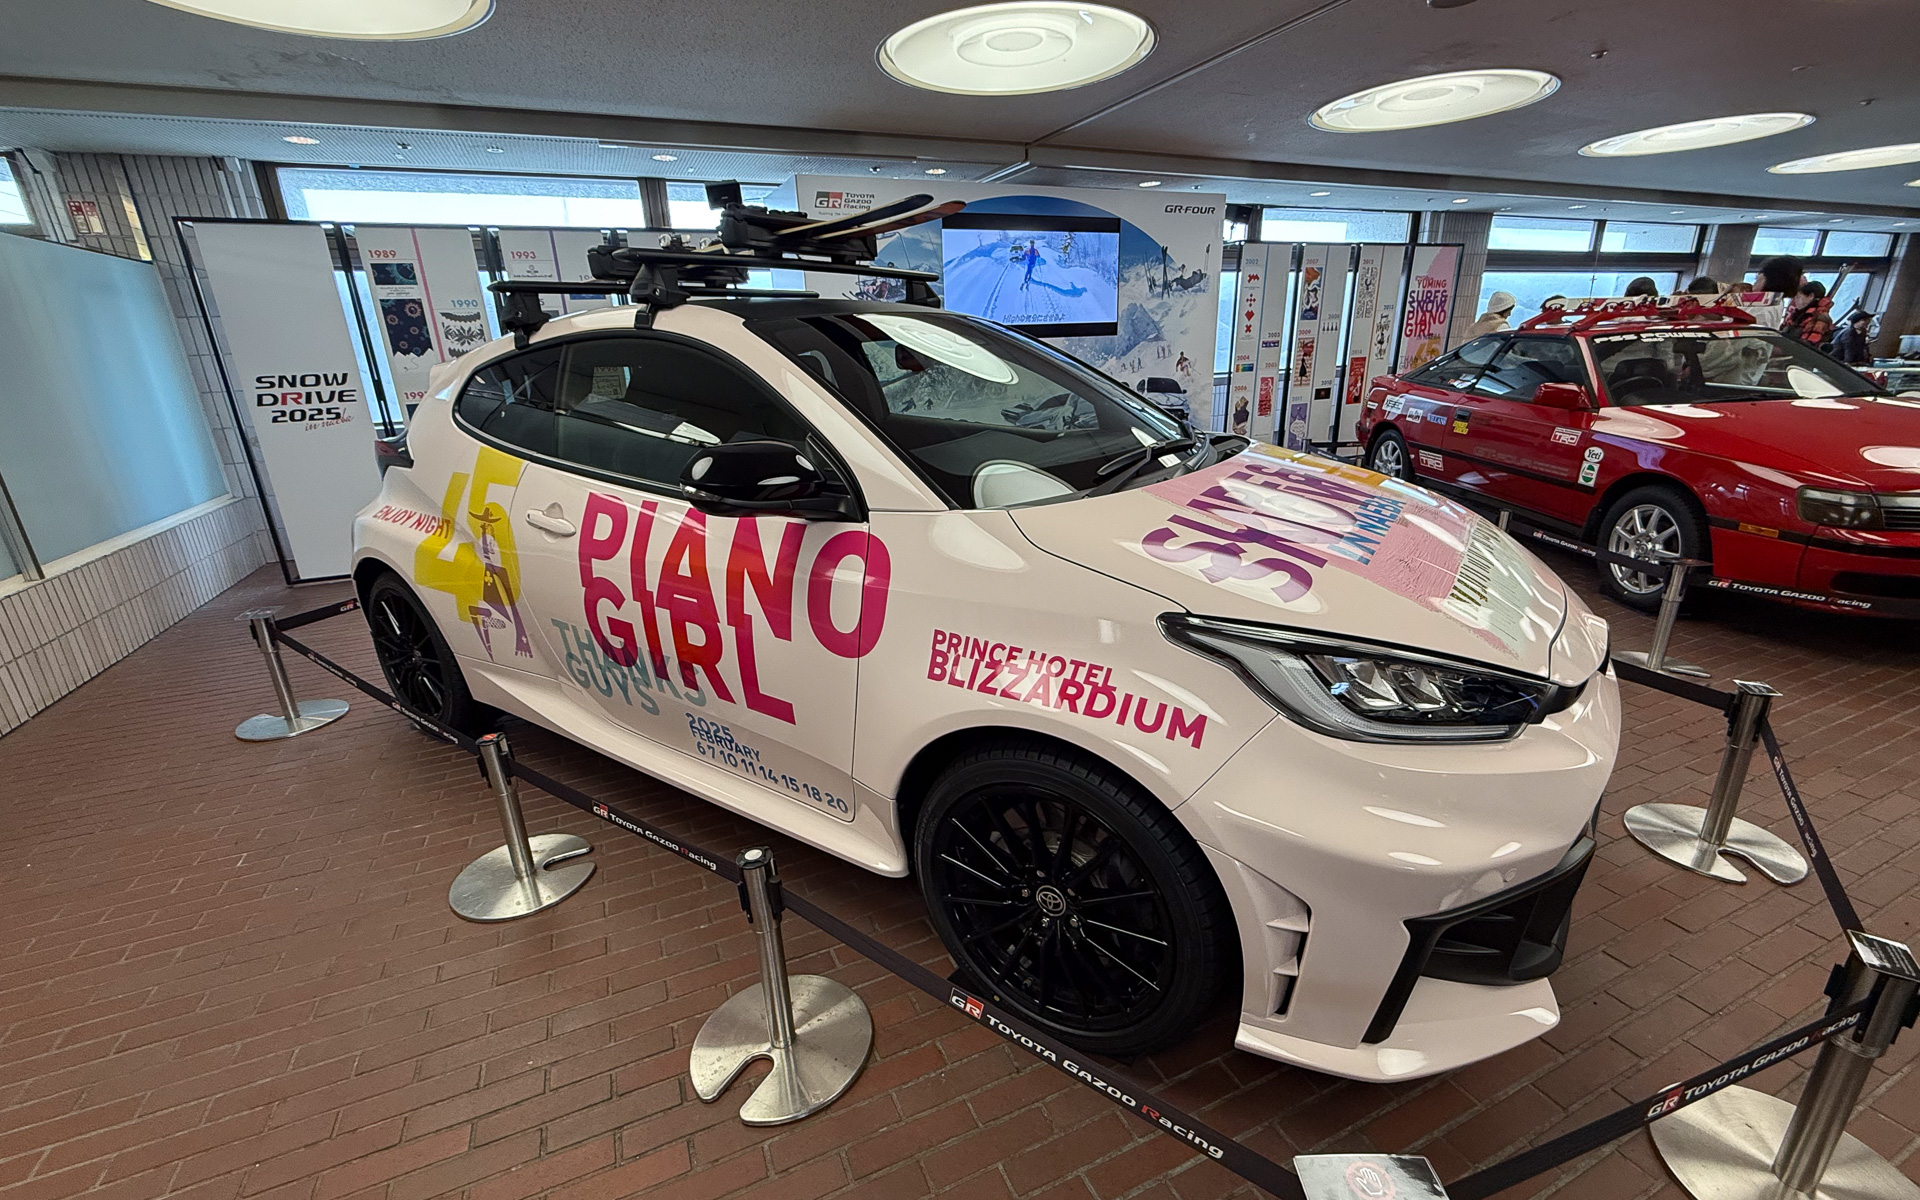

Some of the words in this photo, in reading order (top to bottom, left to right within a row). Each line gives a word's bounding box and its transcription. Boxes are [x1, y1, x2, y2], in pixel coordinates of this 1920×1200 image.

[815, 197, 841, 208] GR
[368, 249, 397, 258] 1989
[510, 250, 537, 260] 1993
[1409, 289, 1448, 302] SURF&
[1417, 279, 1447, 289] YUMING
[451, 299, 478, 308] 1990
[1406, 310, 1447, 326] PIANO
[1408, 299, 1446, 313] SNOW
[1404, 322, 1432, 338] GIRL
[255, 373, 348, 389] SNOW
[404, 391, 427, 399] 199
[257, 389, 357, 407] DRIVE
[271, 407, 342, 423] 2025
[1587, 449, 1602, 460] Yeti
[373, 505, 415, 525] ENJOY
[409, 512, 451, 539] NIGHT
[1353, 495, 1407, 537] NAEBA
[414, 446, 524, 623] 45
[1327, 532, 1381, 566] IN
[578, 491, 892, 658] PIANO
[1708, 580, 1730, 588] GR
[1732, 582, 1779, 595] TOYOTA
[1780, 590, 1826, 601] GAZOO
[551, 618, 707, 707] THANKS
[584, 576, 797, 725] GIRL
[932, 628, 1024, 667] PRINCE
[1027, 650, 1117, 692] HOTEL
[565, 652, 660, 716] GUYS
[927, 649, 1208, 750] BLIZZARDIUM
[685, 712, 735, 745] 2025
[690, 726, 760, 762] FEBRUARY
[697, 741, 706, 755] 6
[707, 745, 716, 759] 7
[719, 750, 738, 768] 10
[741, 758, 757, 776] 11
[759, 765, 779, 784] 14
[781, 774, 800, 793] 15
[802, 783, 823, 802] 18
[824, 792, 849, 814] 20
[1790, 797, 1805, 826] GAZOO
[593, 804, 609, 818] GR
[609, 813, 644, 835] TOYOTA
[645, 830, 679, 851] GAZOO
[680, 847, 717, 871] Racing
[951, 994, 982, 1019] GR
[986, 1013, 1057, 1062] TOYOTA
[1062, 1058, 1137, 1108] GAZOO
[1141, 1104, 1224, 1160] Racing
[1647, 1095, 1680, 1118] GR
[1684, 1064, 1750, 1101] TOYOTA
[1751, 1036, 1809, 1069] GAZOO
[1810, 1012, 1861, 1042] Racing
